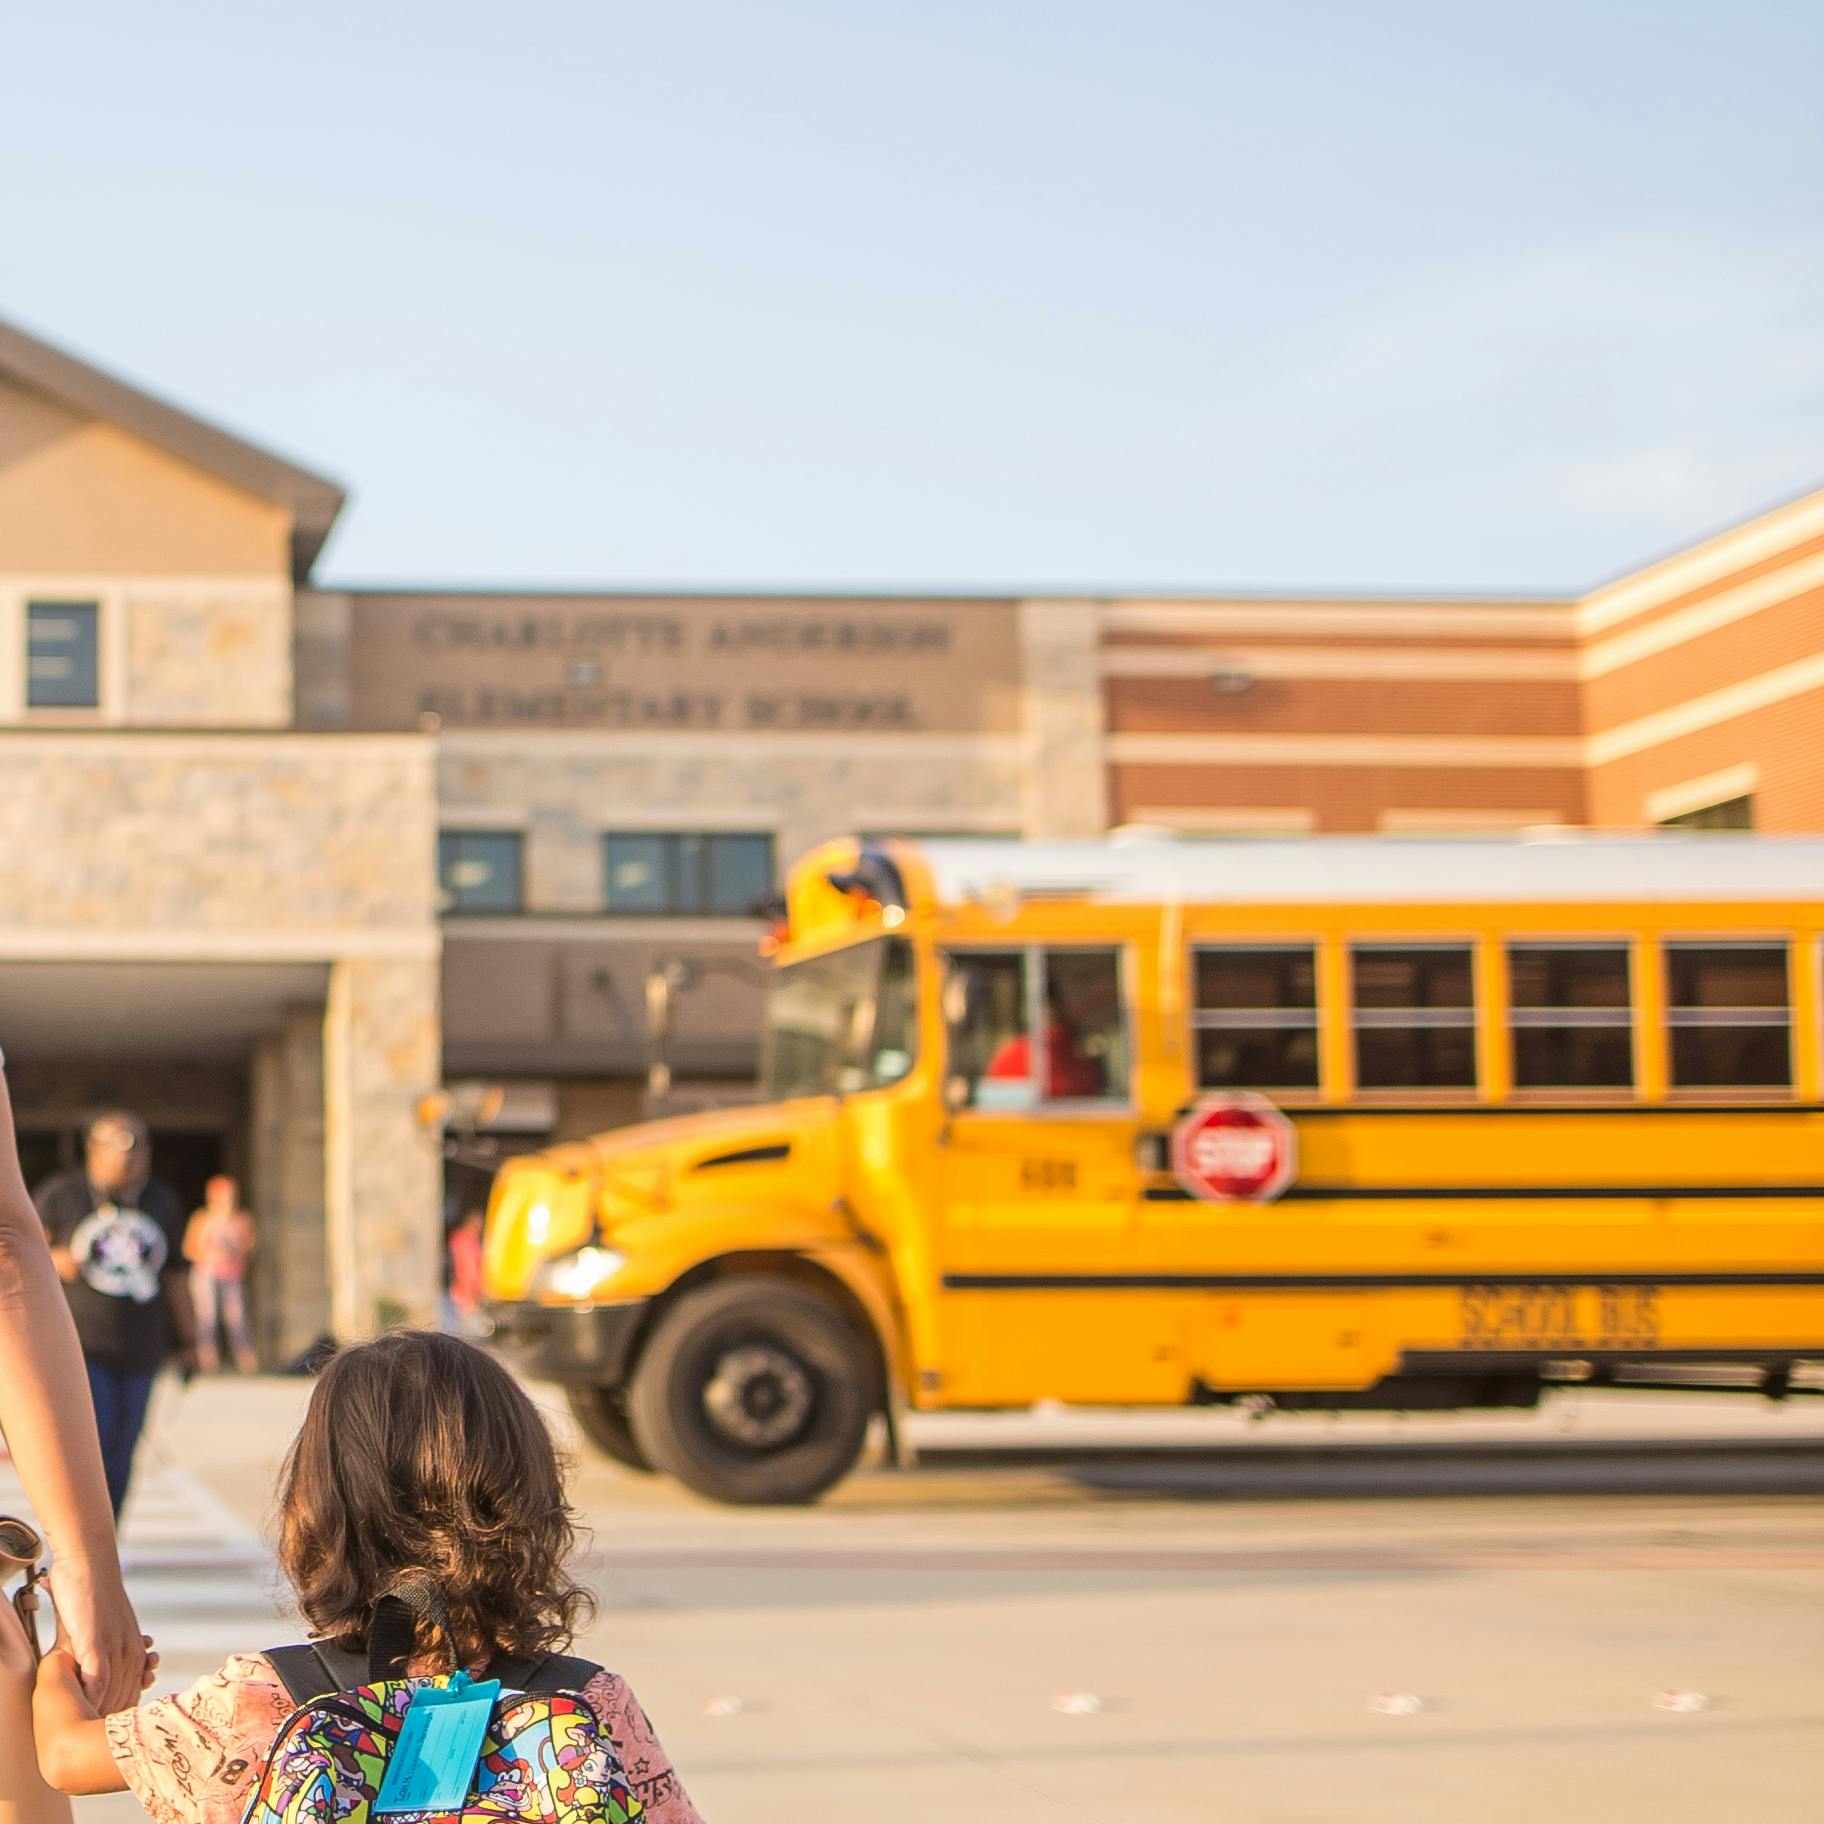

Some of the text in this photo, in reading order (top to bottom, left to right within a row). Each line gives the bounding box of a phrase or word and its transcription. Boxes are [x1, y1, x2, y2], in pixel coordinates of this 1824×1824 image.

[1196, 1128, 1273, 1177] STOP
[1458, 1284, 1662, 1349] SCHOOL BUS
